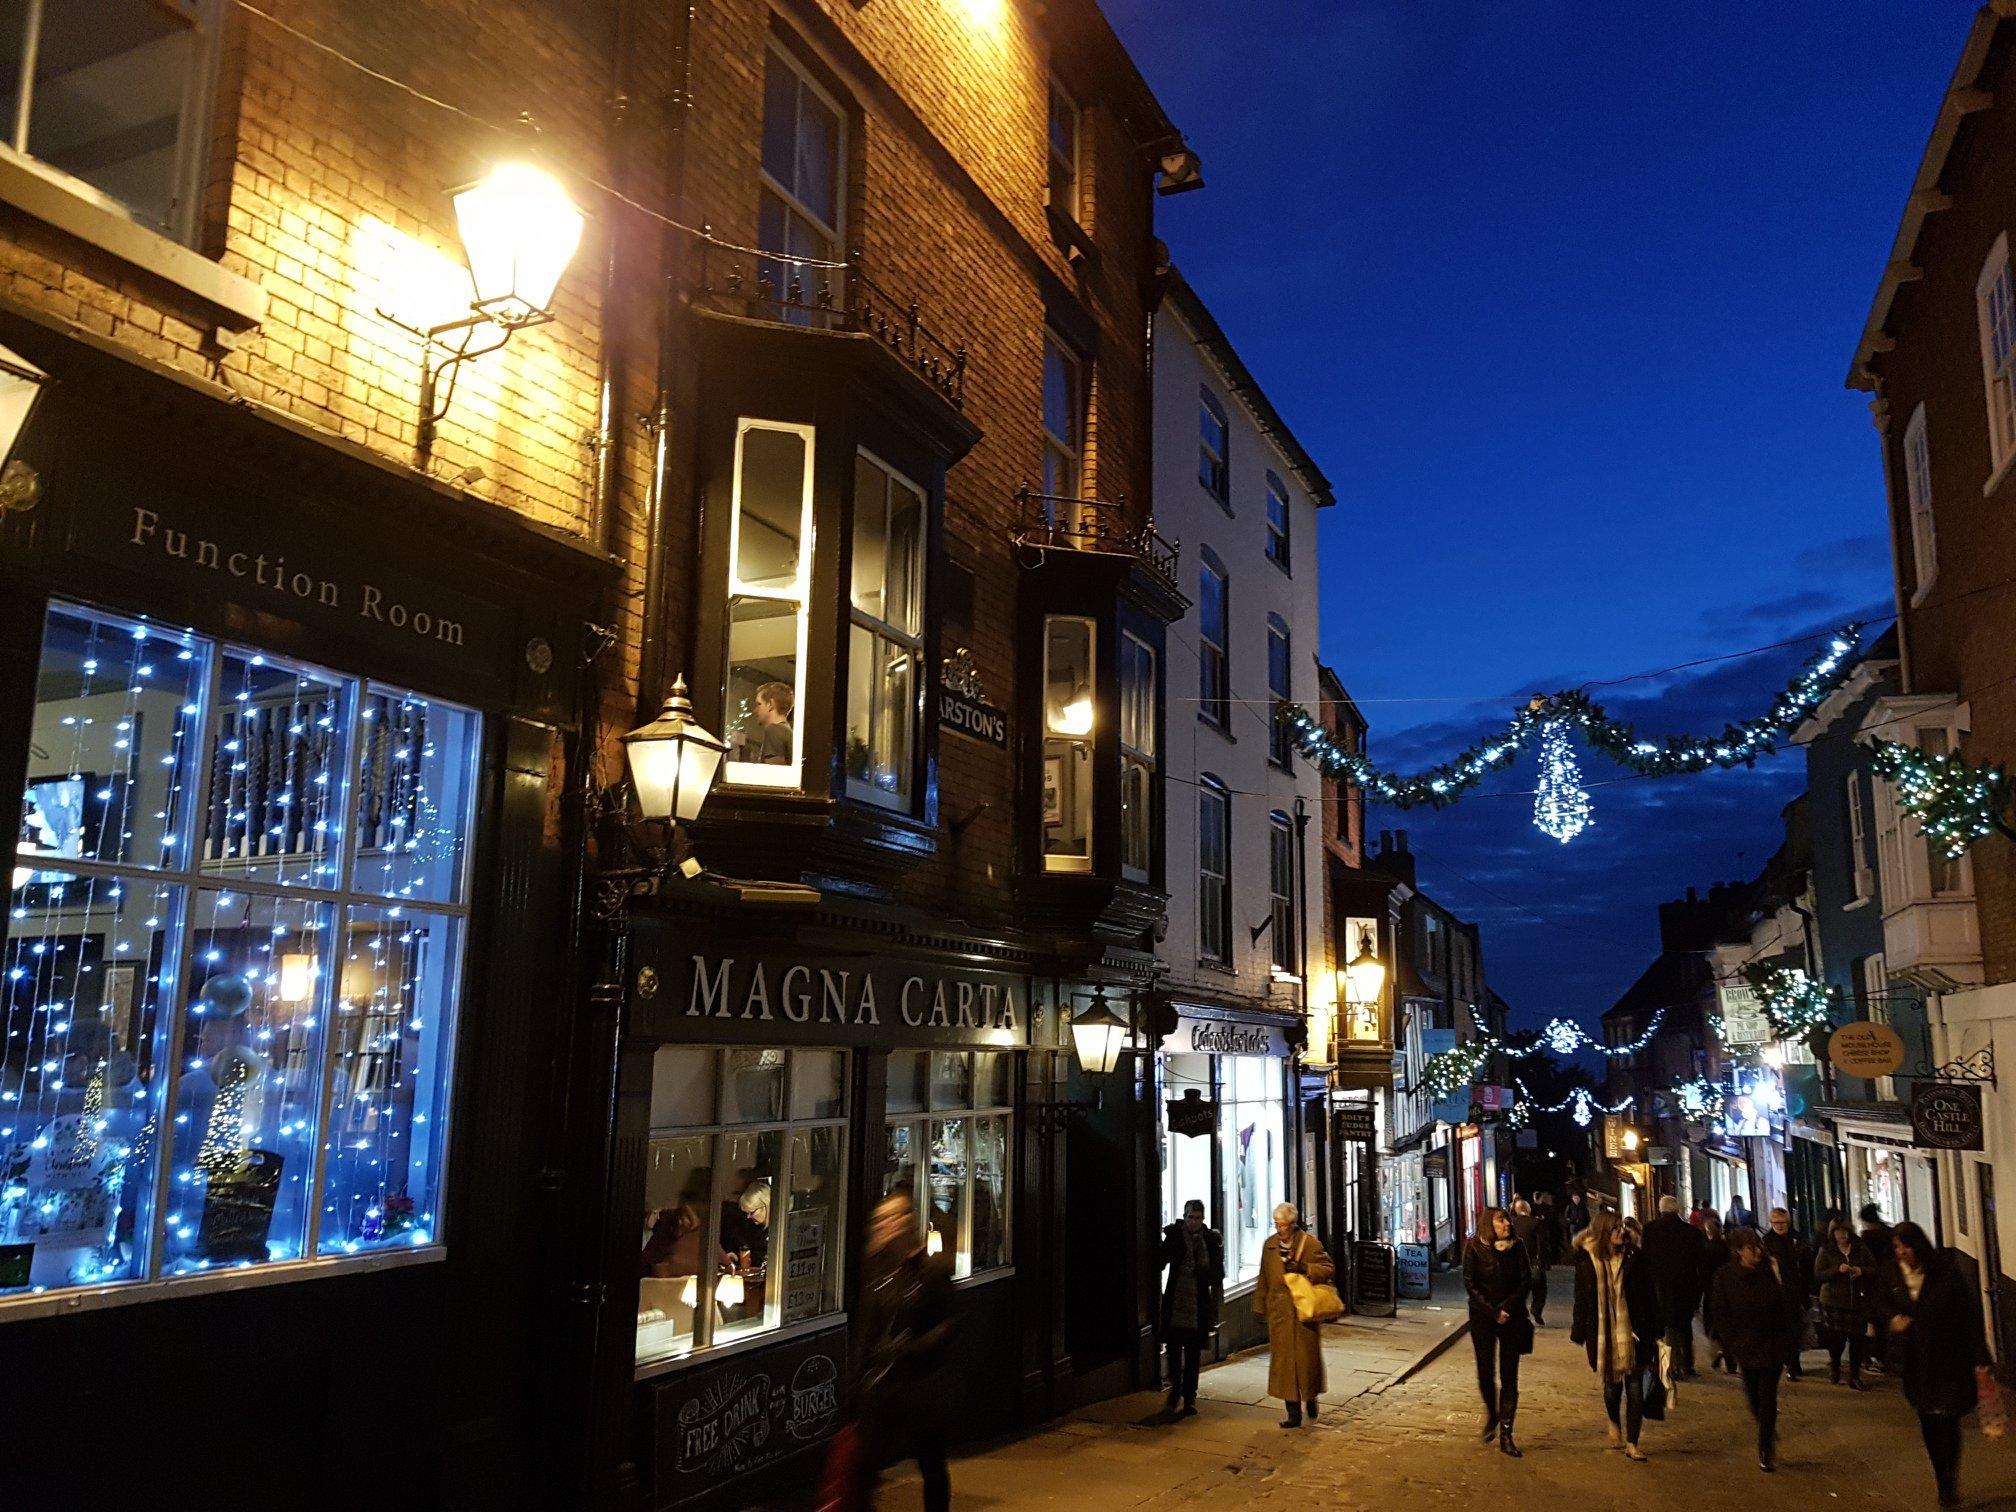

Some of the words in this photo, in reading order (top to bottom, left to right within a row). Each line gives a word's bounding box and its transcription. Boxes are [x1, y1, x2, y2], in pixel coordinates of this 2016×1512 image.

[130, 506, 339, 607] Function
[359, 584, 464, 646] Room
[685, 954, 881, 1025] MAGNA
[901, 975, 1019, 1031] CARTA
[1925, 1108, 1971, 1122] CASTLE
[1933, 1099, 1960, 1112] ONE
[1401, 1258, 1428, 1267] ROOM
[1405, 1248, 1423, 1258] TEA
[793, 1384, 838, 1421] BURGER
[685, 1418, 719, 1459] FREE
[724, 1384, 760, 1438] DRINK
